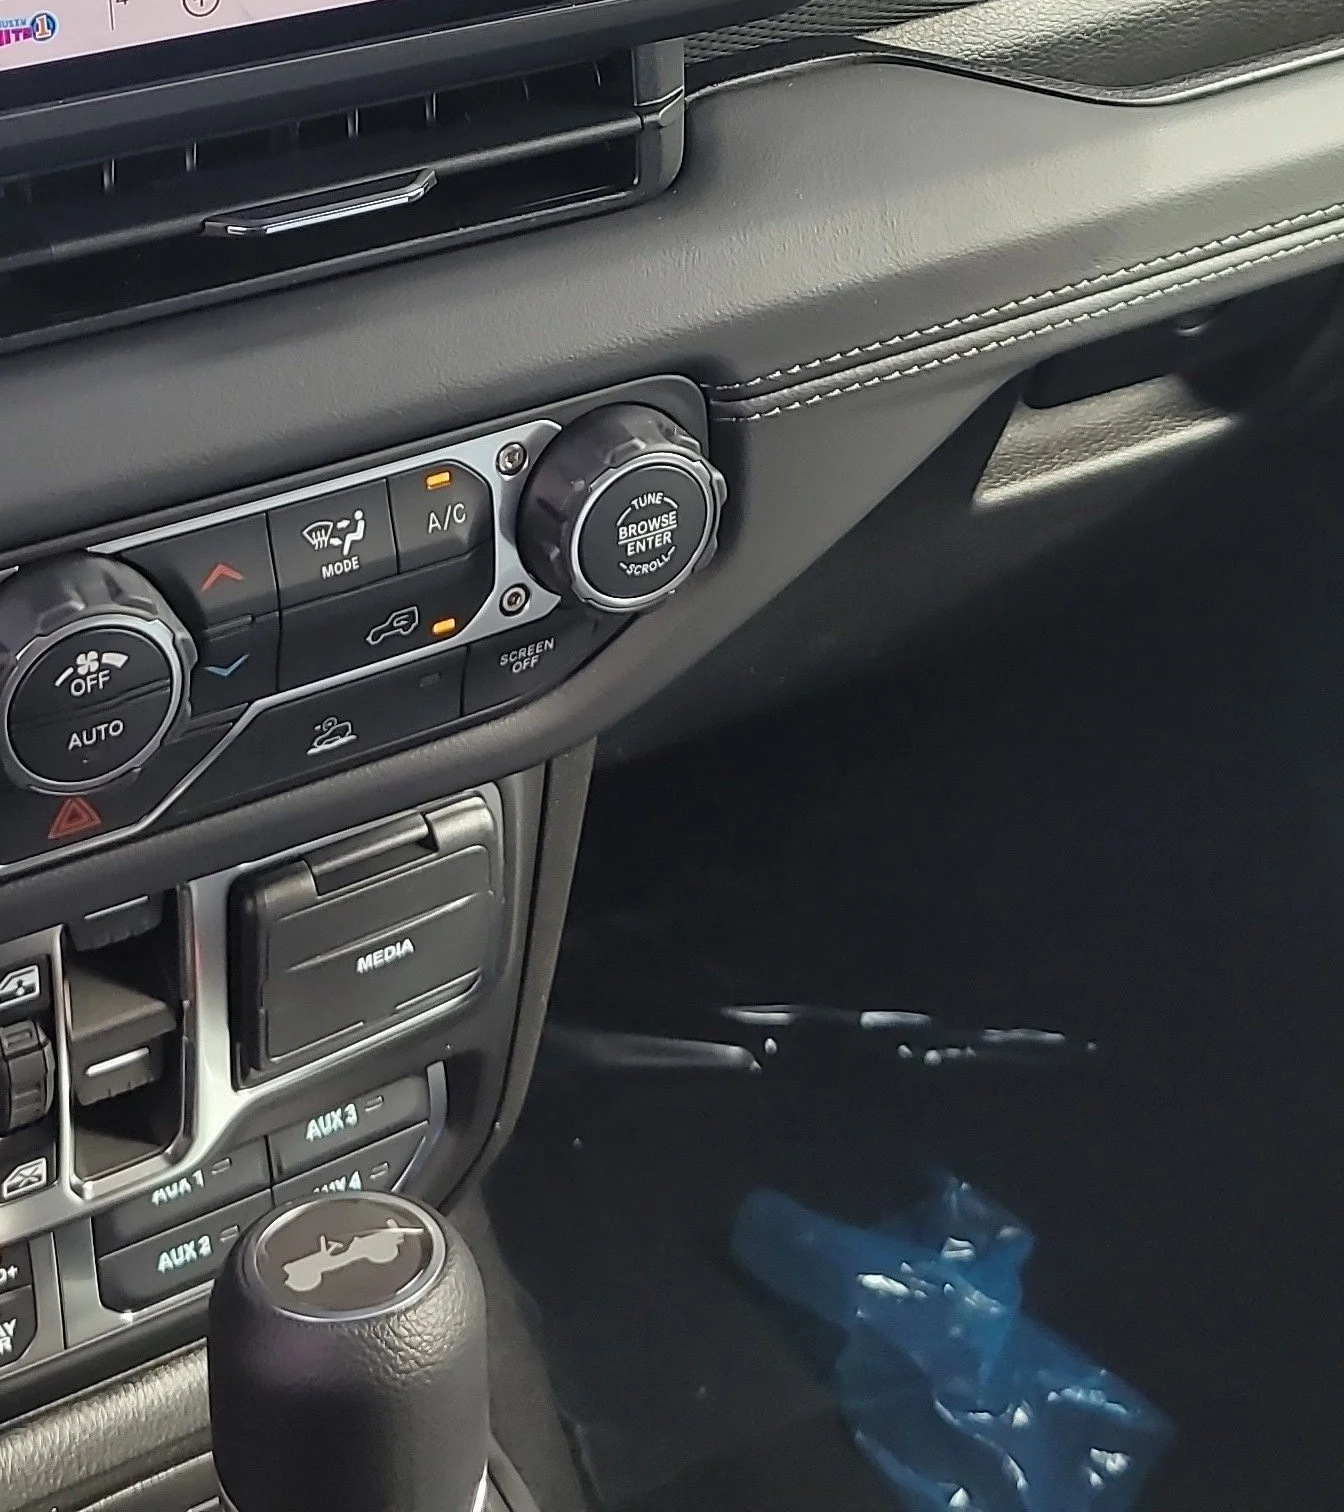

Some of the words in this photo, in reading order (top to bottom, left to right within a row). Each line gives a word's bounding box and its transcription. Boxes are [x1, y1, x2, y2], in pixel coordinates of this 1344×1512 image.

[630, 491, 664, 511] TUNE
[427, 502, 468, 535] A/C
[618, 510, 677, 540] BROWSE
[626, 531, 673, 557] ENTER
[321, 555, 360, 580] MODE
[625, 554, 671, 576] SCROLL
[500, 637, 555, 666] SCREEN
[512, 654, 540, 674] OFF
[70, 669, 111, 697] OFF
[68, 719, 124, 751] AUTO
[356, 937, 416, 974] MEDIA
[306, 1106, 344, 1143] AUX
[342, 1102, 359, 1128] 3
[156, 1240, 199, 1275] AUX
[196, 1234, 214, 1258] 2
